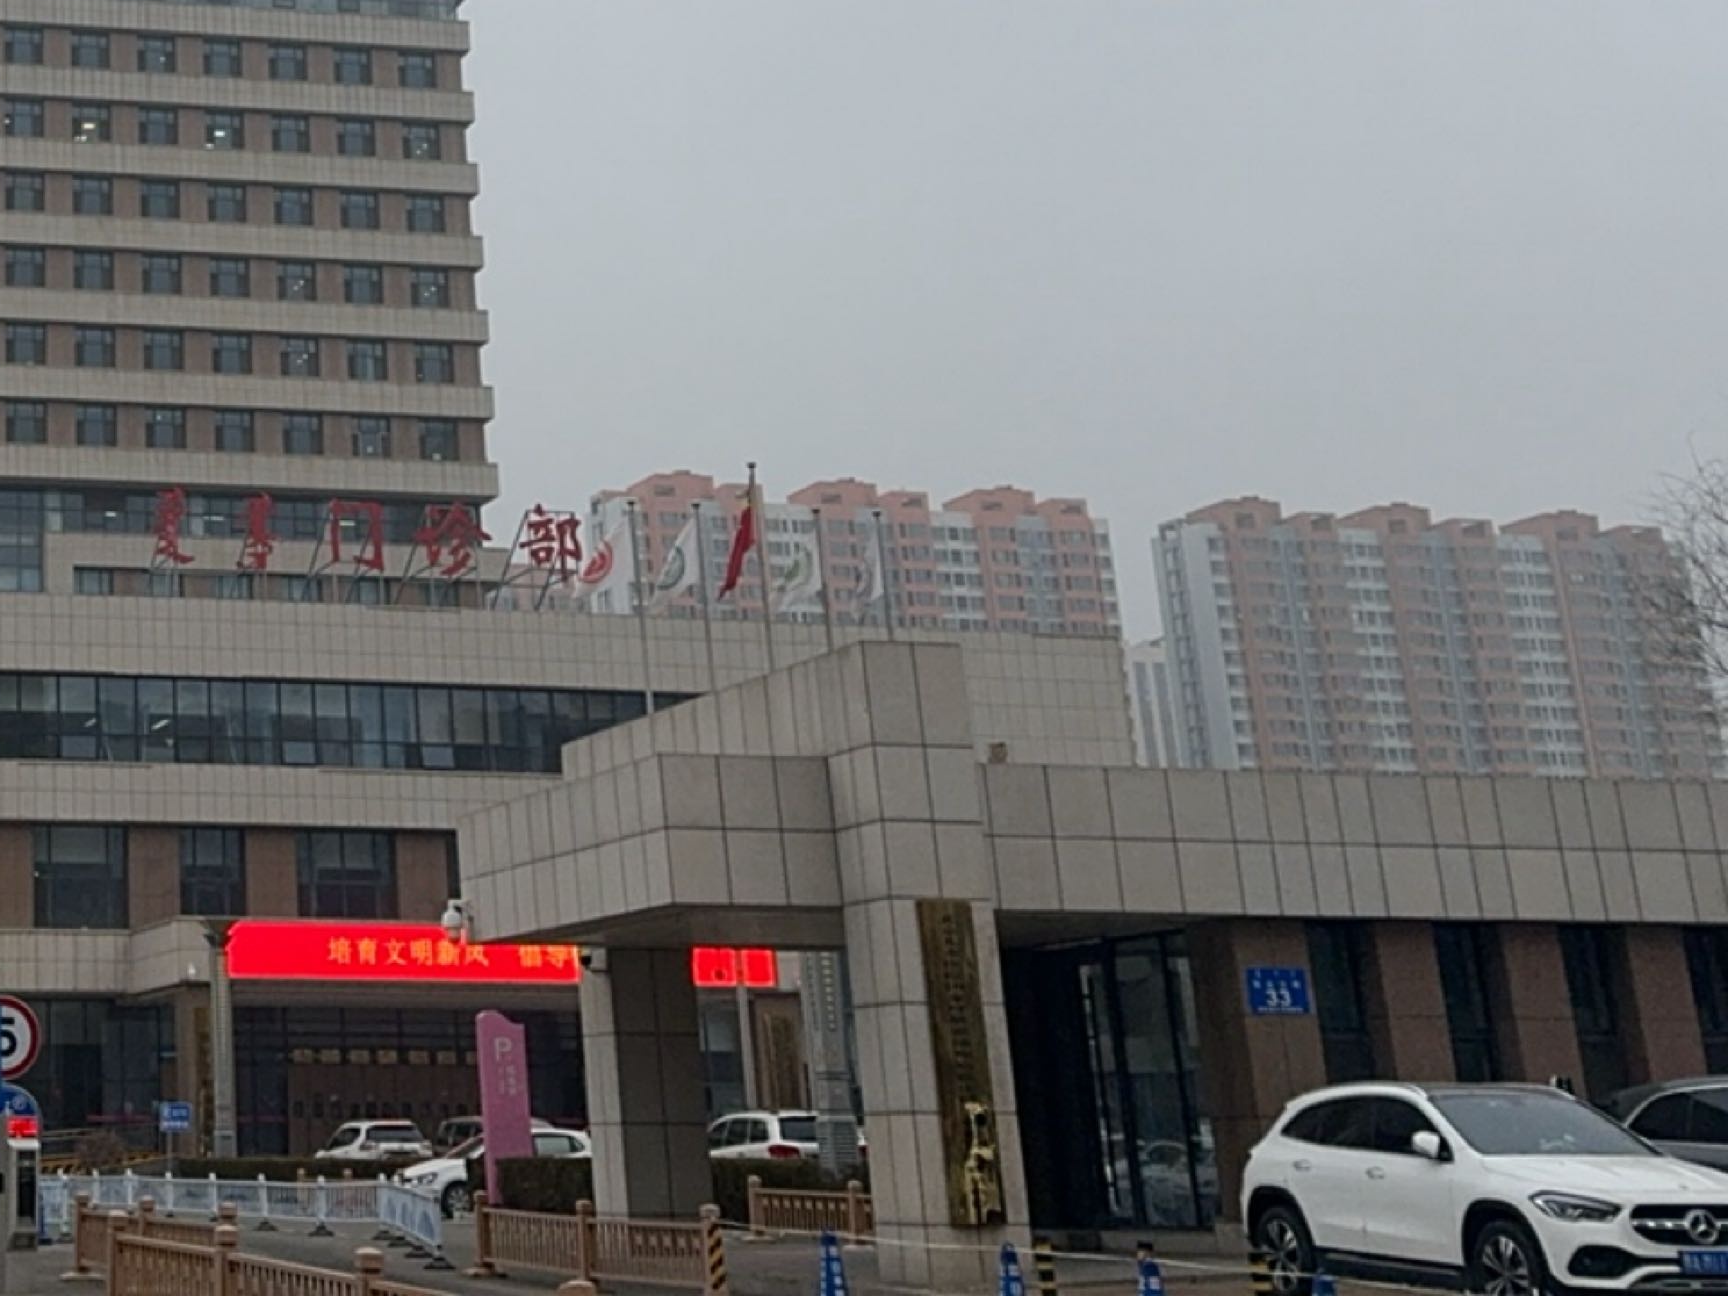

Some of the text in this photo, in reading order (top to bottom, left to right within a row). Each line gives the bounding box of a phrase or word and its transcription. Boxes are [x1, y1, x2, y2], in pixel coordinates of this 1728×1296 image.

[329, 499, 582, 582] 门诊部
[328, 936, 489, 967] 培育文明新风
[0, 1015, 17, 1057] 5
[493, 1036, 513, 1062] P
